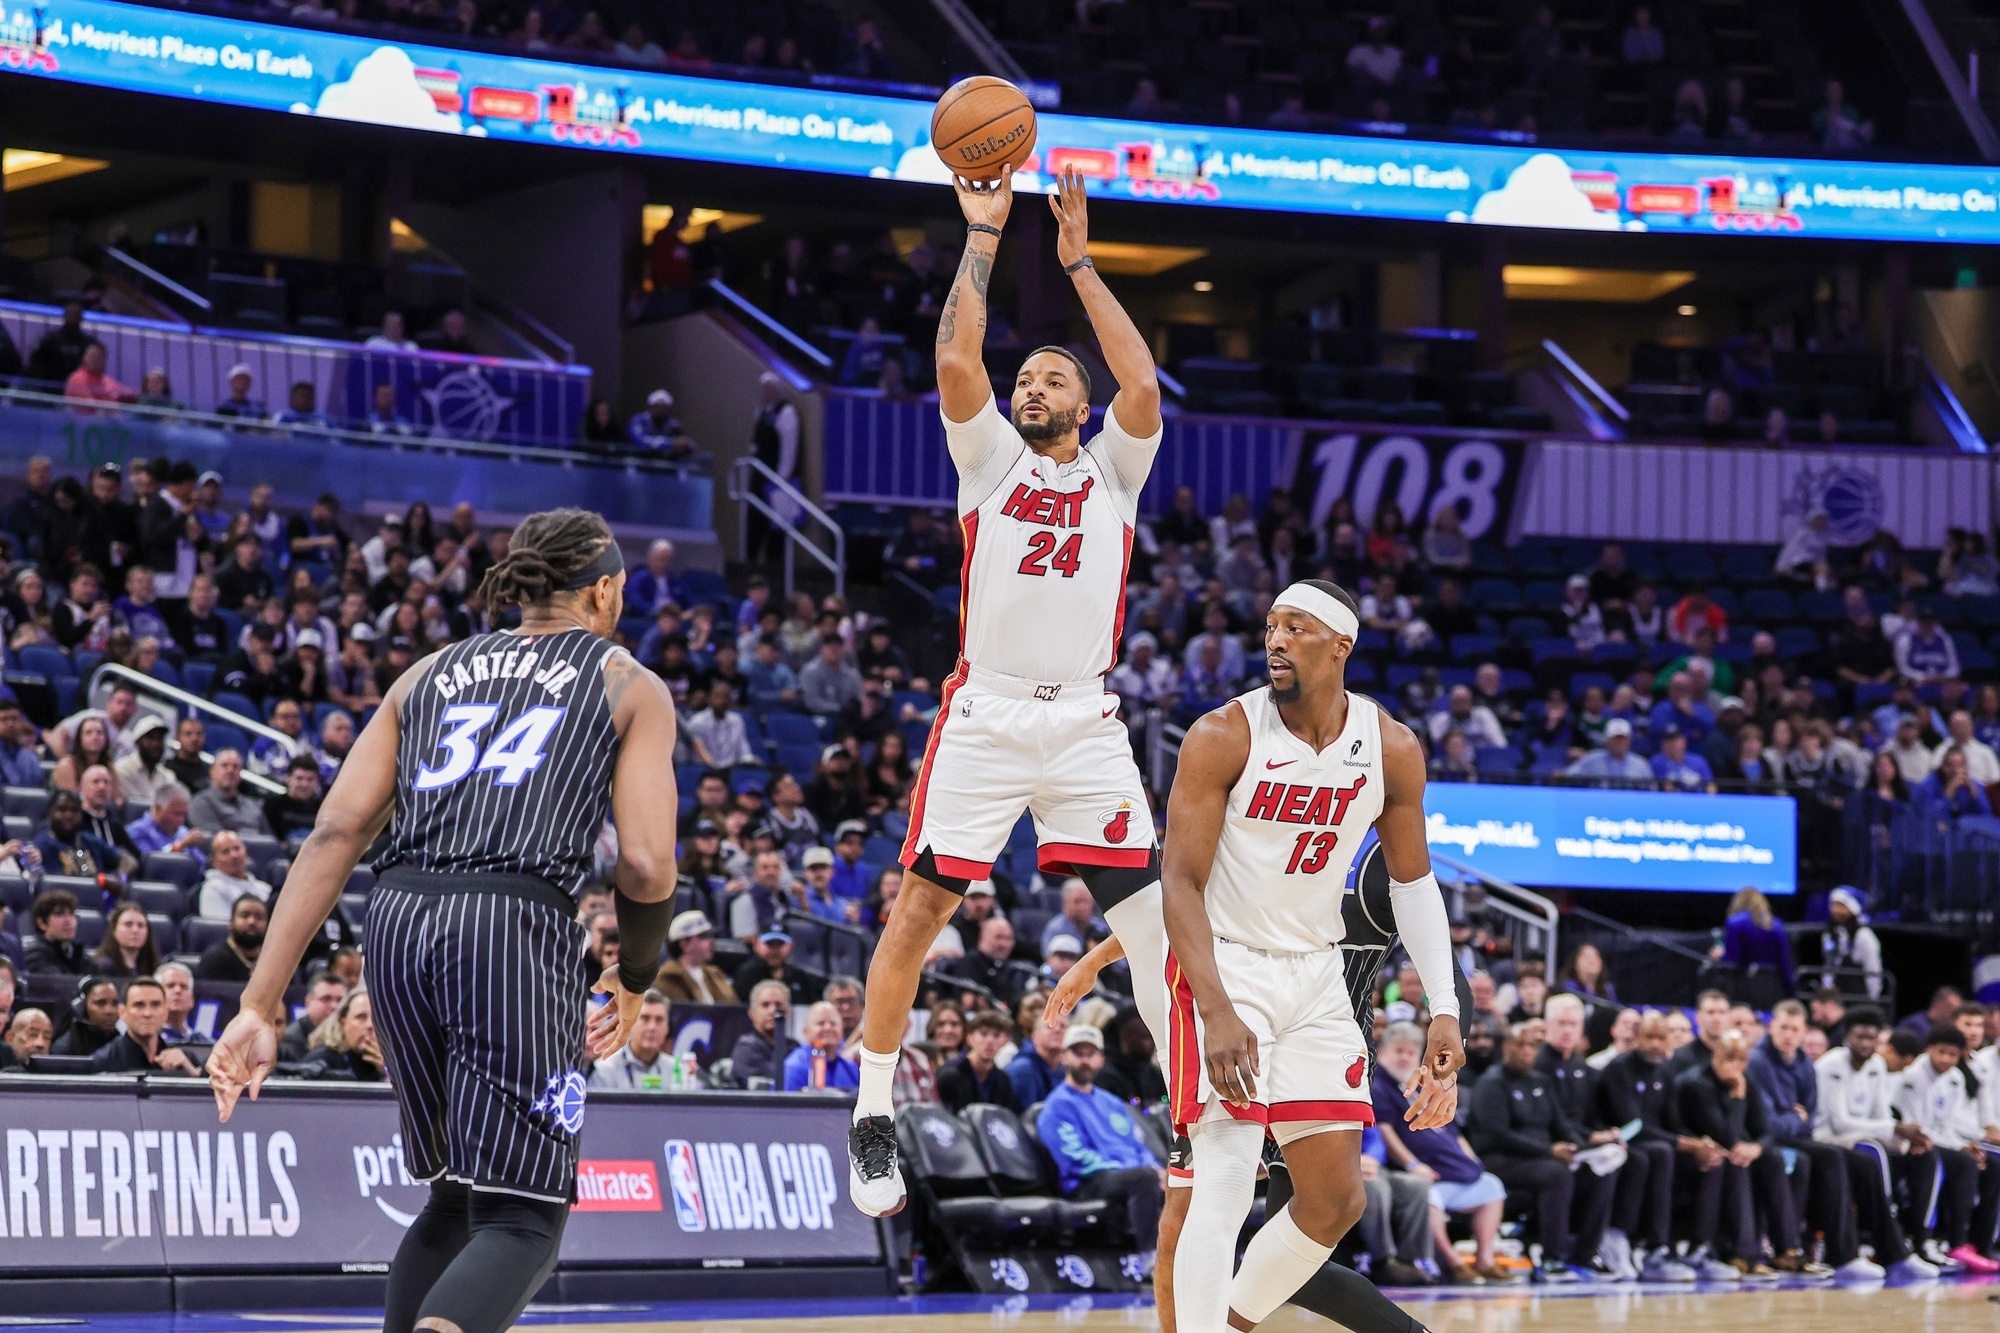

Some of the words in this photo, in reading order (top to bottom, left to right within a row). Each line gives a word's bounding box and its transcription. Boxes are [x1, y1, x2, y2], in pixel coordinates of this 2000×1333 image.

[72, 23, 159, 58] Merriest
[161, 36, 218, 66] Place
[220, 45, 253, 70] On
[256, 49, 312, 78] Earth
[654, 99, 742, 130] Merriest
[743, 108, 801, 135] Place
[802, 114, 835, 138] On
[837, 118, 893, 144] Earth
[958, 124, 1026, 162] Wilson
[1319, 158, 1377, 184] Place
[1378, 162, 1412, 186] On
[1413, 165, 1470, 190] Earth
[1903, 187, 1961, 211] Place
[1962, 189, 1997, 212] On
[62, 420, 132, 466] 107
[1000, 476, 1094, 528] HEAT
[1310, 434, 1505, 541] 108
[1017, 531, 1084, 578] 24
[433, 650, 539, 700] CARTER
[534, 659, 579, 700] JR.
[412, 702, 568, 792] 34
[1343, 759, 1371, 768] Robinhood
[1245, 773, 1367, 826] HEAT
[1284, 831, 1338, 875] 13
[0, 1129, 300, 1238] RTERFINALS
[352, 1132, 431, 1197] pri
[695, 1142, 776, 1230] NBA
[768, 1142, 838, 1230] CUP
